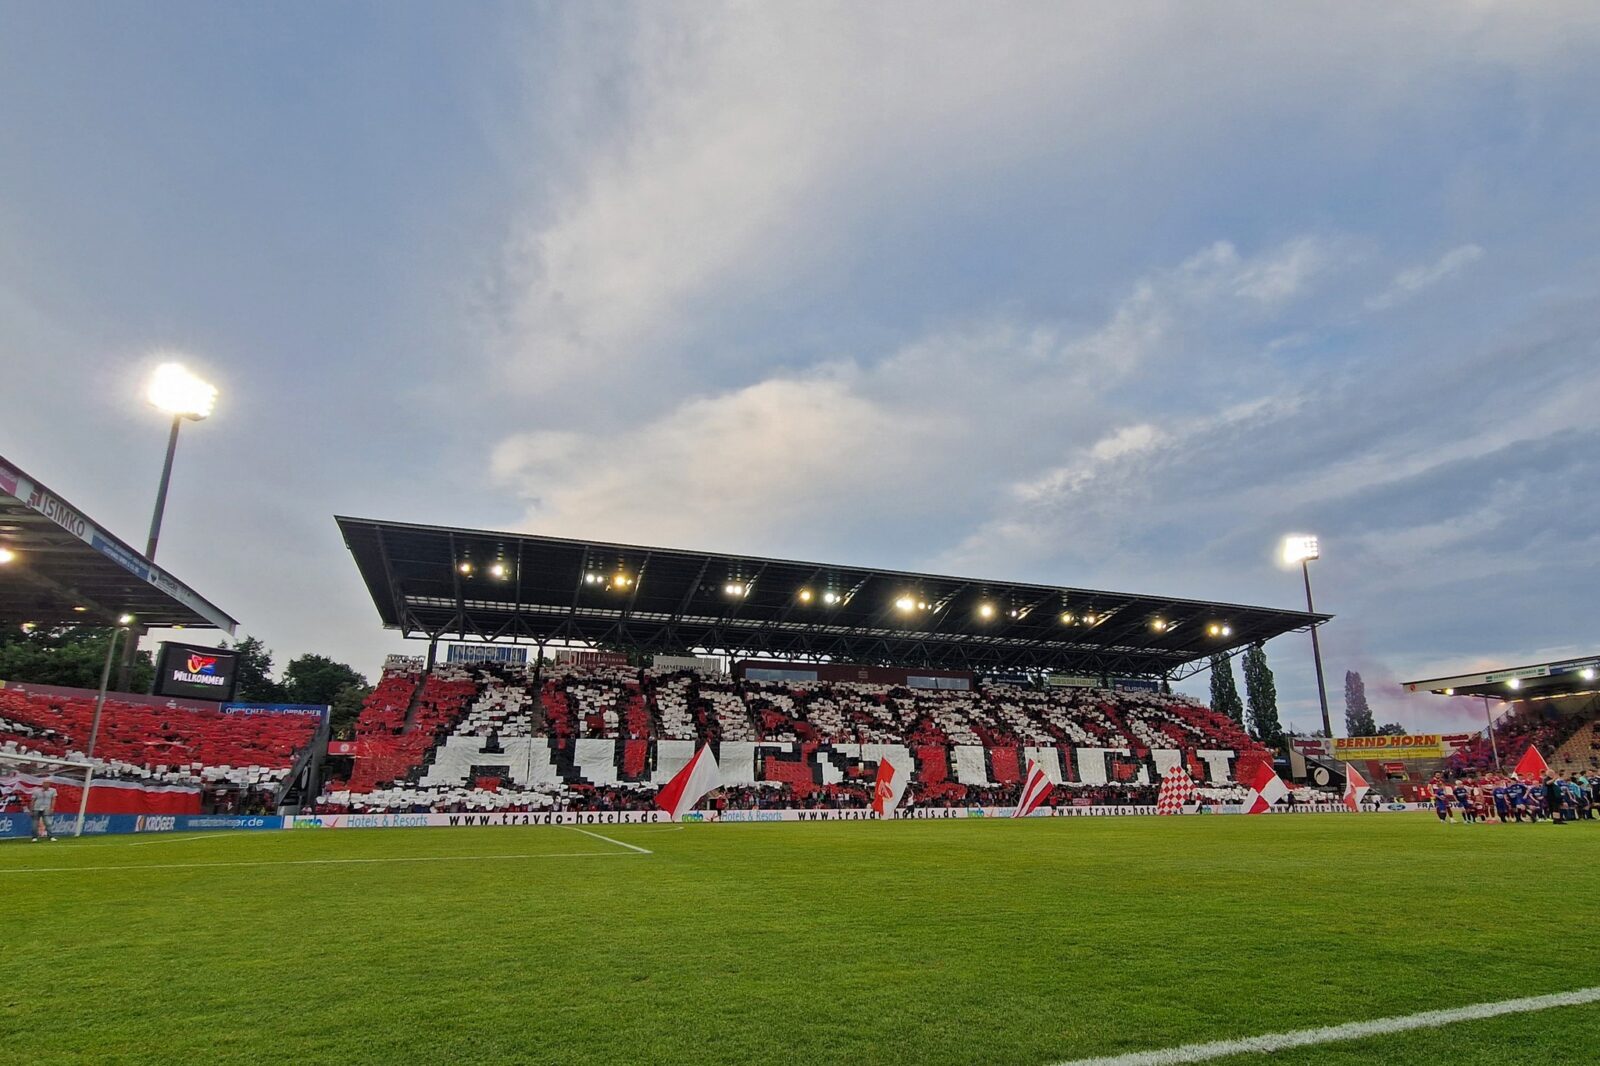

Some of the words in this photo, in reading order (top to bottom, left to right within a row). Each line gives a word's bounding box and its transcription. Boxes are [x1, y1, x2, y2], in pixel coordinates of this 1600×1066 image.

[42, 495, 86, 538] ISIMKO
[1336, 737, 1387, 749] BERND
[1390, 735, 1437, 747] HORN
[144, 814, 176, 832] KRÖGER
[347, 816, 378, 828] Hotels
[381, 816, 389, 827] &
[393, 815, 428, 828] Resorts
[449, 809, 658, 827] www.travdo-hotels.de
